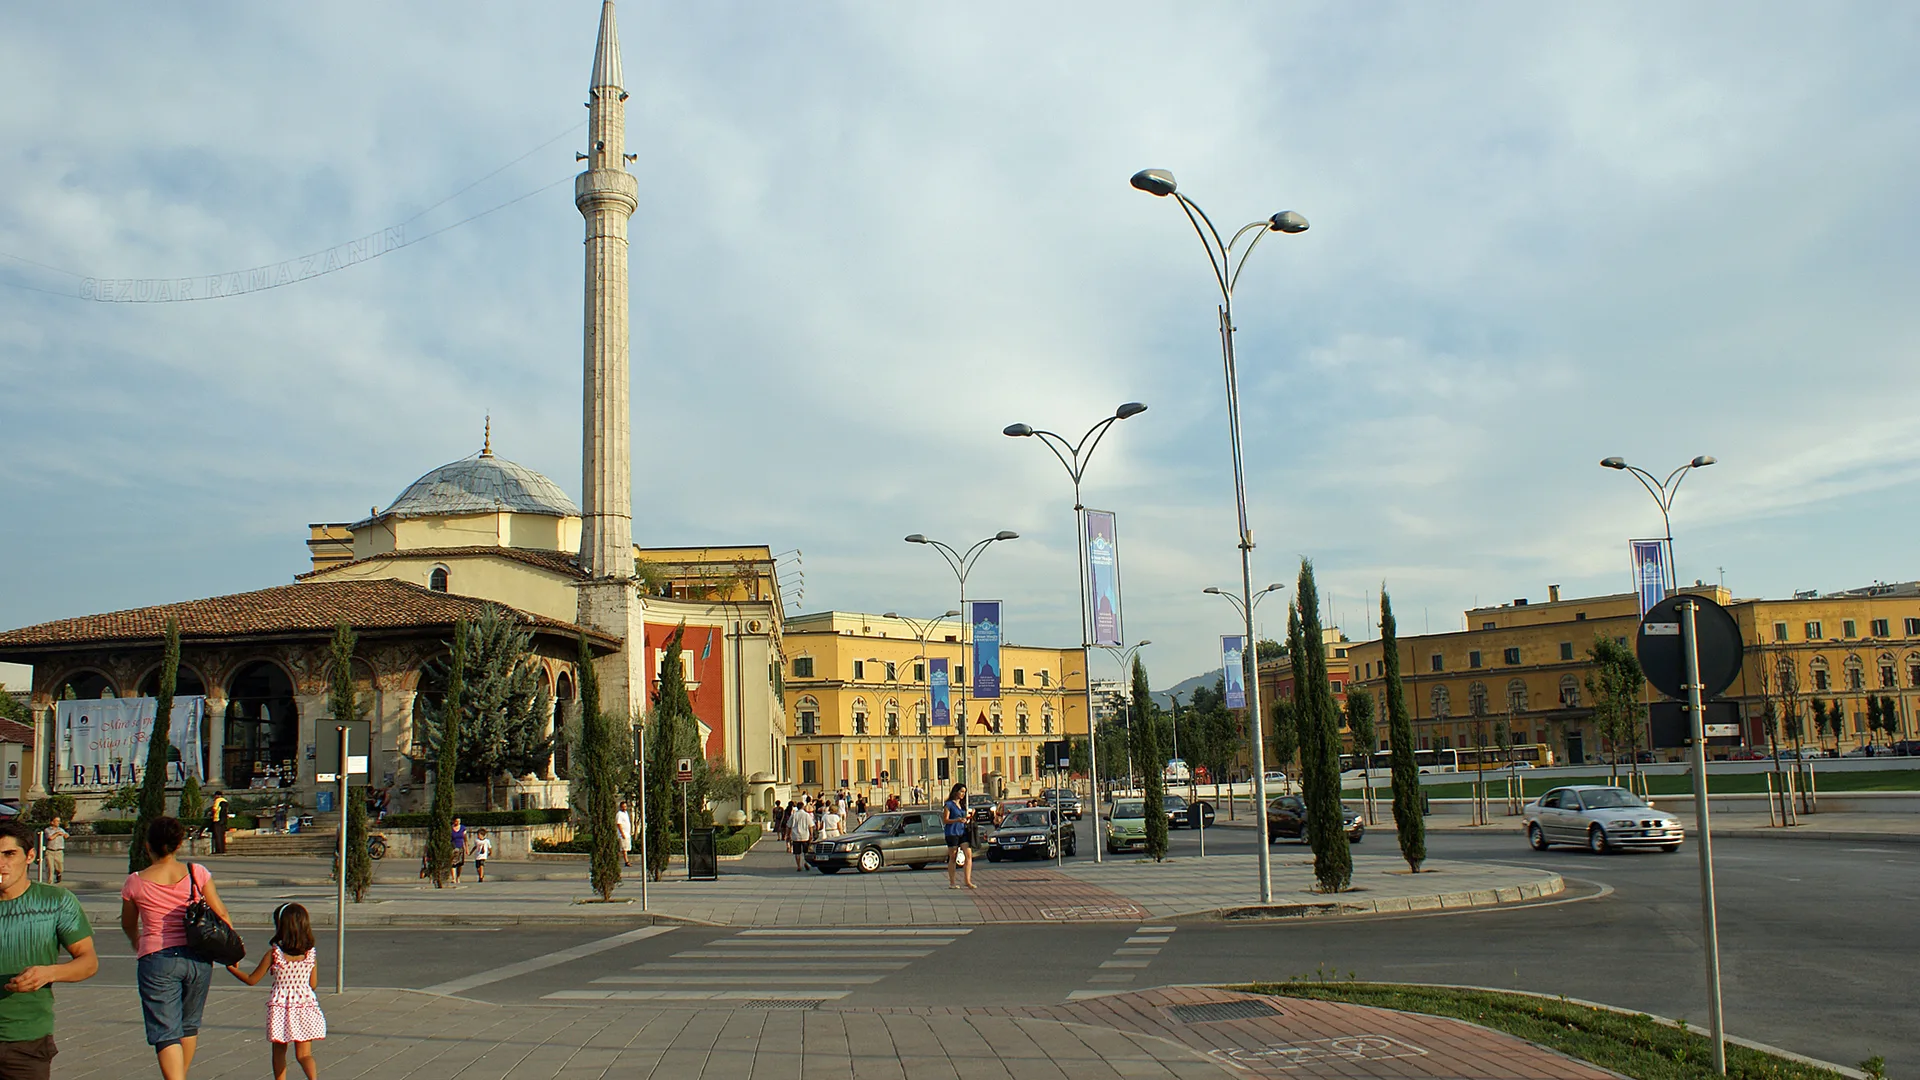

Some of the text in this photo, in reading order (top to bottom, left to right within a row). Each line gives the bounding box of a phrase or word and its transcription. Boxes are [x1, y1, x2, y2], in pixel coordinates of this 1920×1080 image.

[79, 225, 405, 302] GEZUAR RAMAZANIN
[74, 761, 186, 786] RAMAN
